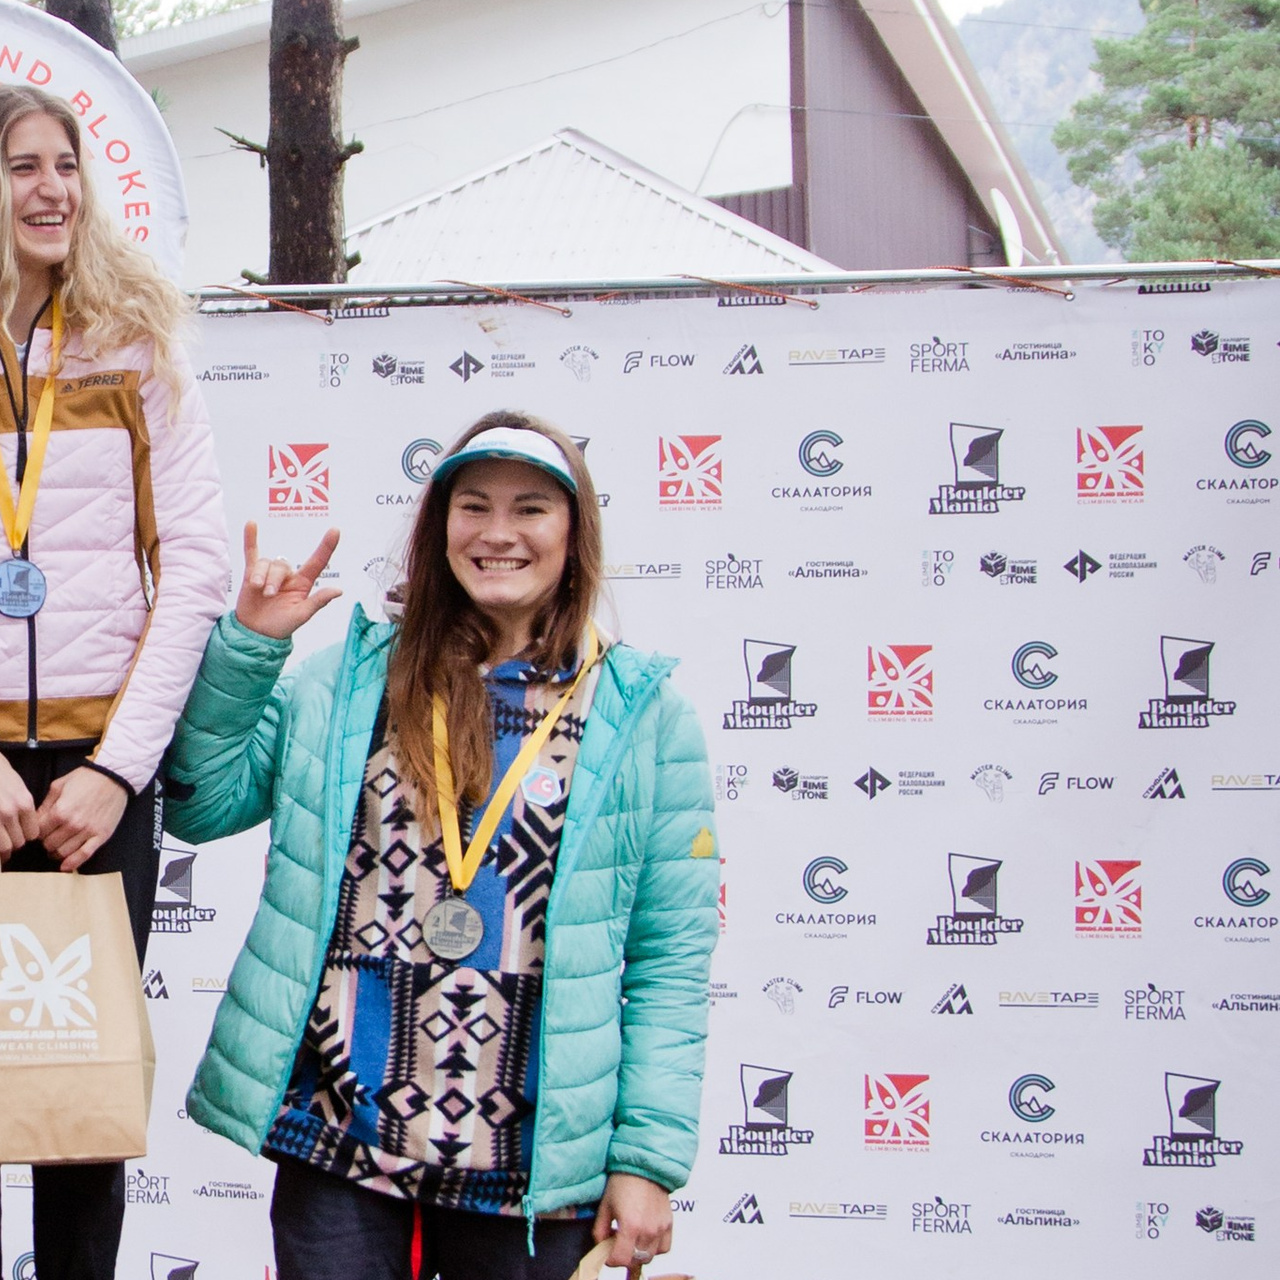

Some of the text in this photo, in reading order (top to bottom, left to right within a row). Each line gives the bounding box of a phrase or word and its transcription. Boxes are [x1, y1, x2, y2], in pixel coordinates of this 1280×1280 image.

[910, 343, 969, 358] SPORT
[651, 355, 695, 367] FLOW
[910, 359, 970, 372] FERMA
[772, 486, 871, 498] СКАЛАТОРИЯ
[939, 484, 1025, 501] Boulder
[929, 499, 999, 514] Mania
[602, 564, 681, 575] AVETAPE
[706, 560, 763, 574] SPORT
[706, 575, 763, 589] FERMA
[733, 700, 818, 717] Boulder
[984, 699, 1087, 710] СКАЛАТОРИЯ
[1148, 699, 1236, 715] Boulder
[723, 714, 791, 729] Mania
[1139, 713, 1210, 728] Mania
[1067, 777, 1114, 789] FLOW
[152, 797, 164, 851] TERREX
[152, 906, 216, 921] oulder
[776, 913, 876, 925] СКАЛАТОРИЯ
[937, 915, 1023, 932] Boulder
[926, 928, 997, 945] Mania
[857, 992, 902, 1004] FLOW
[1125, 990, 1185, 1005] SPORT
[1212, 999, 1280, 1011] «Альпин
[1125, 1006, 1186, 1020] FERMA
[729, 1126, 814, 1143] Boulder
[981, 1131, 1084, 1144] СКАЛАТОРИЯ
[720, 1139, 788, 1155] Mania
[1153, 1136, 1243, 1155] Boulder
[1143, 1148, 1216, 1167] Mania
[127, 1176, 169, 1189] PORT
[209, 1181, 251, 1190] гостиница
[127, 1190, 170, 1204] ERMA
[912, 1203, 971, 1218] SPORT
[1016, 1208, 1065, 1216] гостиница
[912, 1219, 972, 1233] FERMA
